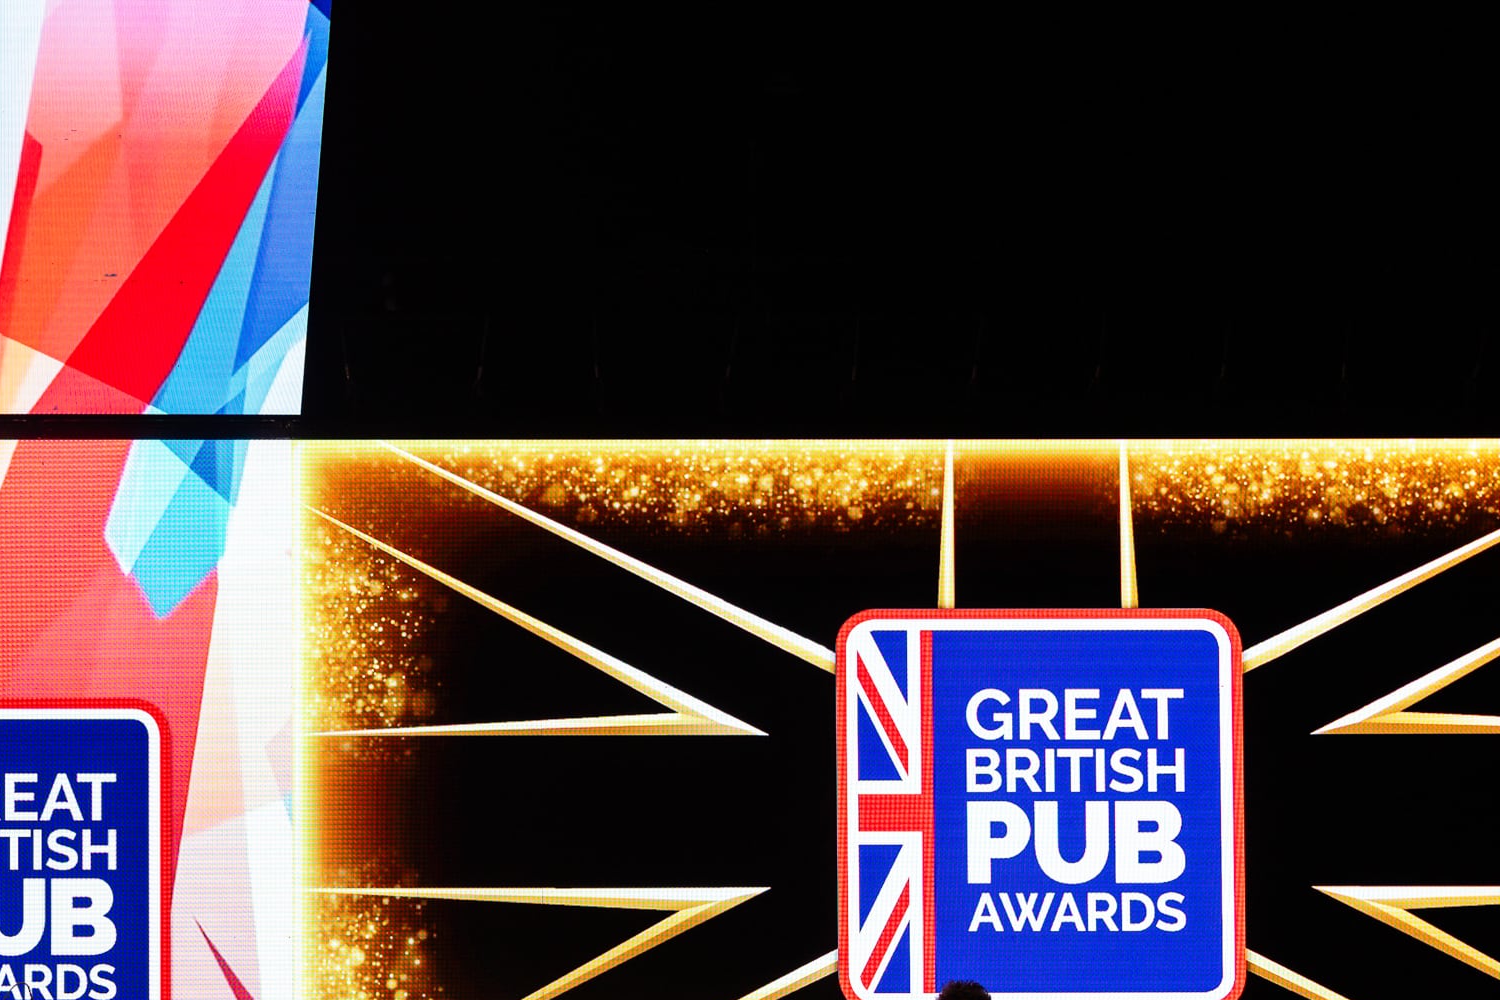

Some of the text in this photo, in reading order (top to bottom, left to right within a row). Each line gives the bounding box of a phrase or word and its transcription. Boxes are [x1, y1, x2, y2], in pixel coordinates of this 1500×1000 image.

[965, 688, 1185, 740] GREAT
[965, 747, 1186, 793] BRITISH
[966, 801, 1186, 885] PUB
[968, 891, 1187, 932] AWARDS
